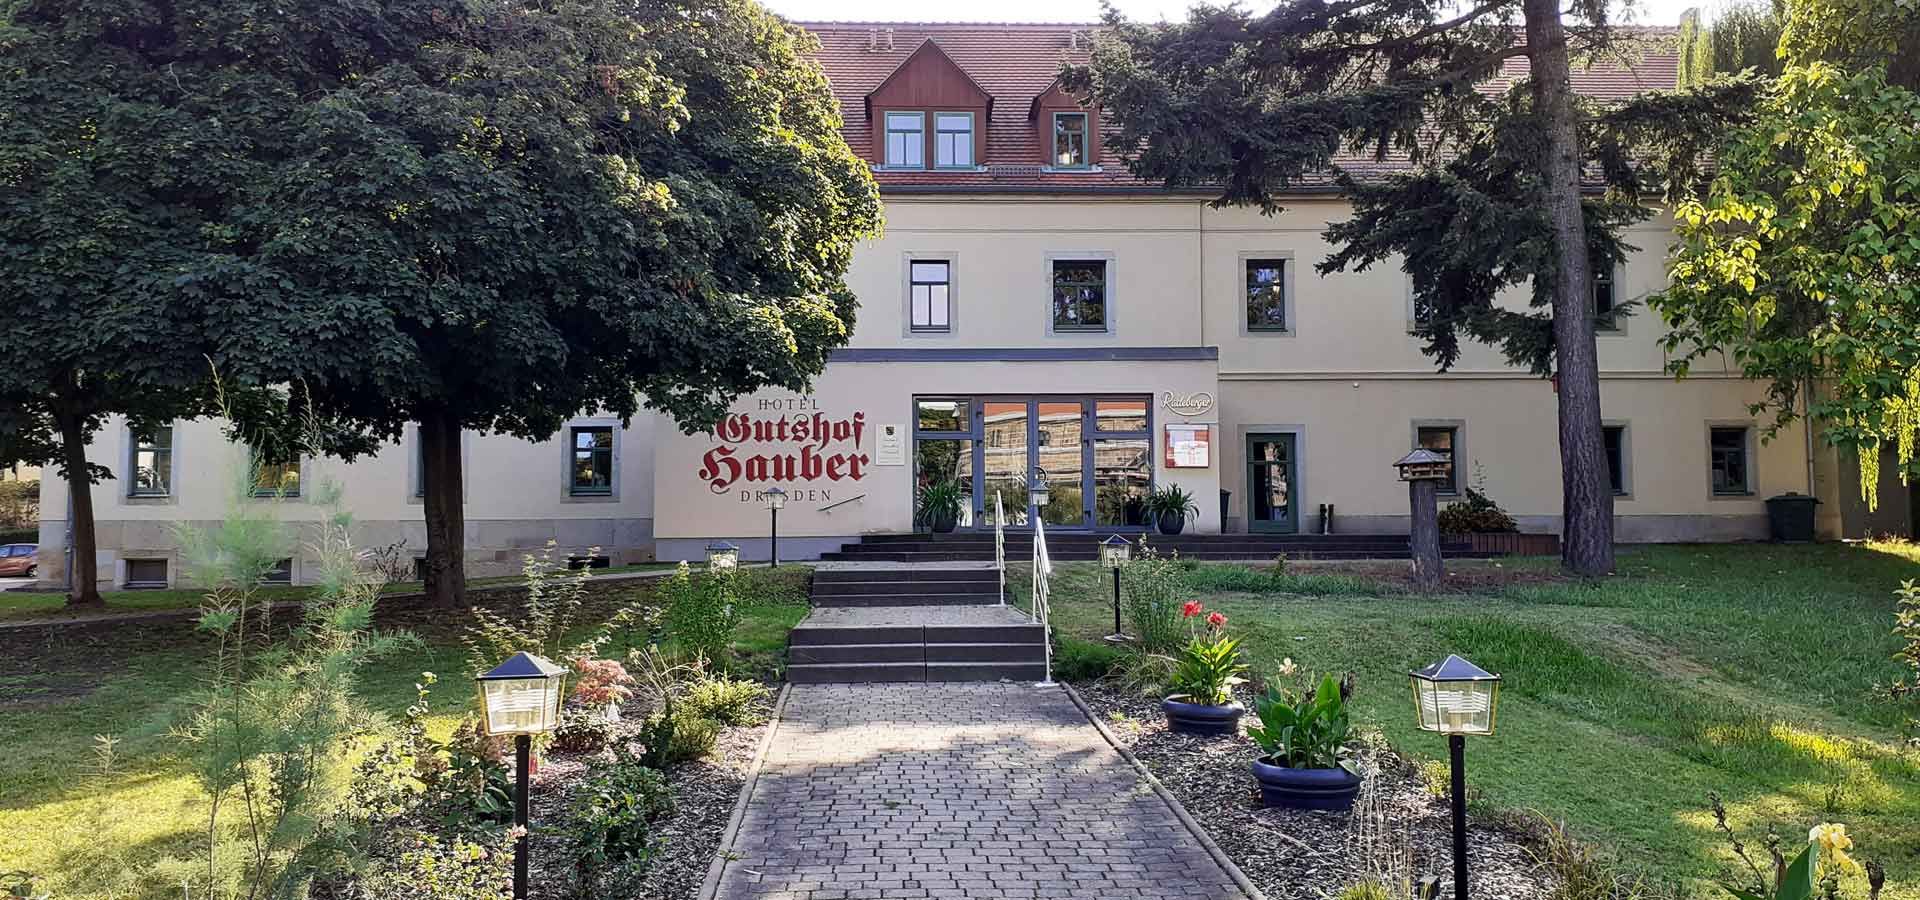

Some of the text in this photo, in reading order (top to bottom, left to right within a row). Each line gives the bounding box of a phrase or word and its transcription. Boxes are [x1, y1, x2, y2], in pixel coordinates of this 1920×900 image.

[759, 398, 821, 410] HOTEL
[1160, 391, 1211, 411] Radeberger
[716, 411, 865, 451] Gutshof
[698, 444, 870, 495] Hauber
[741, 489, 832, 502] DRSDEN
